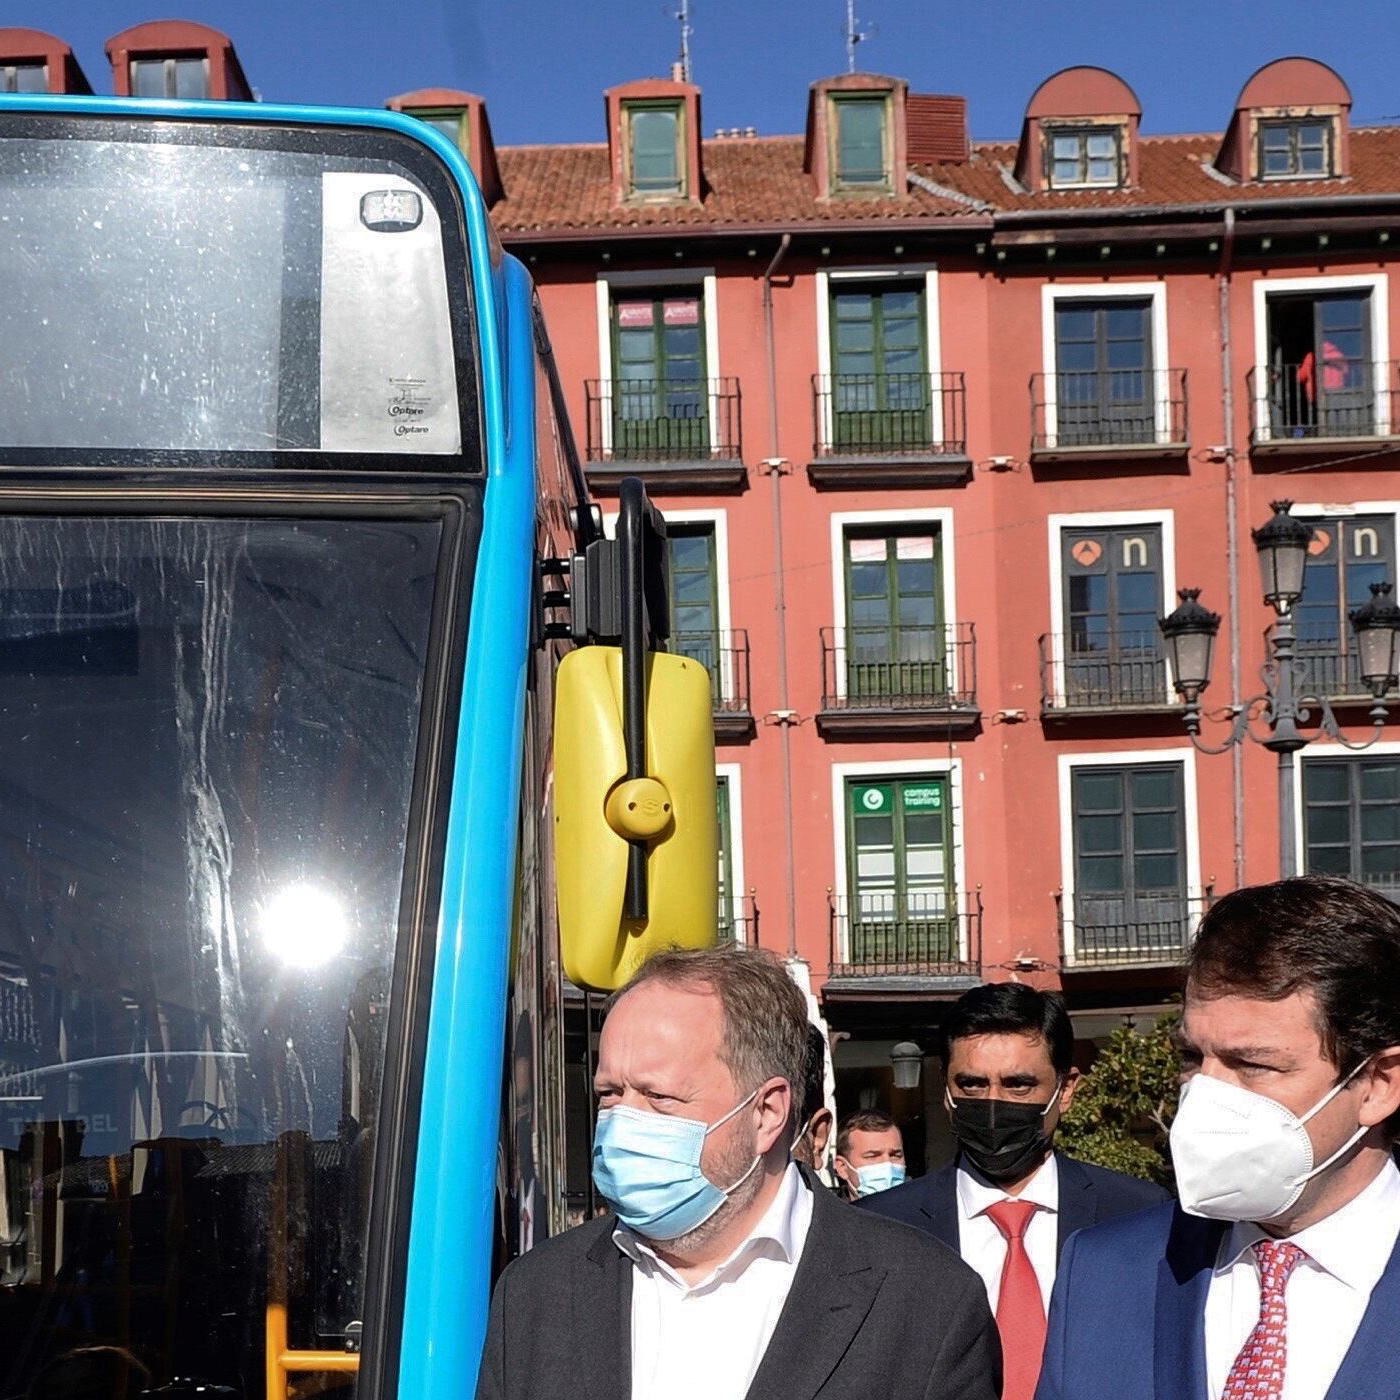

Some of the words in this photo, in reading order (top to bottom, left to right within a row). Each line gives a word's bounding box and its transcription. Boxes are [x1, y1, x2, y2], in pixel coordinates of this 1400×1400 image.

[1354, 527, 1378, 556] n
[1122, 537, 1147, 567] n
[904, 788, 940, 799] campus
[905, 797, 941, 807] training
